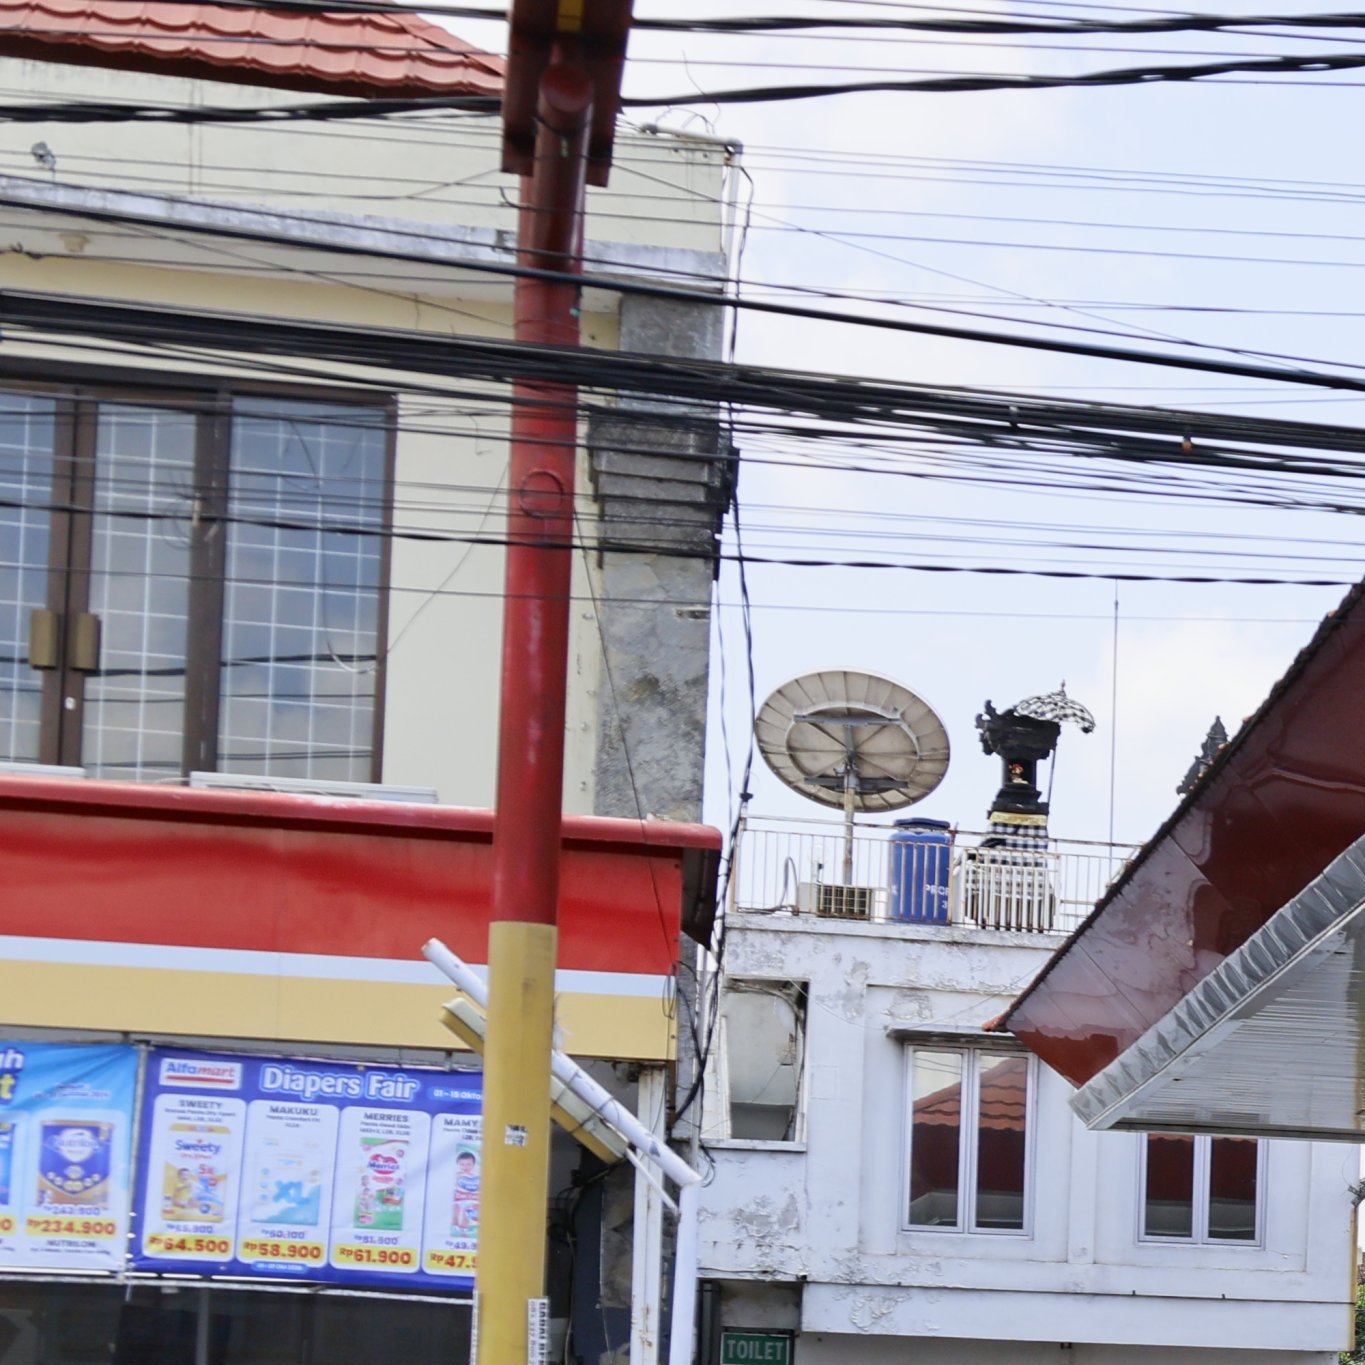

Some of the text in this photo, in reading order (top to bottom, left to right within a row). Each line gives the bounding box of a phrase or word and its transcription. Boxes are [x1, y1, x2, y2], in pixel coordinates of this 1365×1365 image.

[166, 1061, 236, 1078] Alfamart
[264, 1066, 417, 1098] Diapers Fair
[269, 1105, 317, 1116] MAKUKU
[364, 1112, 408, 1123] MERRIES
[444, 1118, 478, 1127] MAMY
[175, 1139, 221, 1155] Sweety
[27, 1218, 116, 1235] Rp234.900
[149, 1236, 229, 1253] Rp64.500
[244, 1241, 322, 1259] Rp58.900
[339, 1247, 412, 1265] Rp61.900
[727, 1340, 783, 1361] TOILET
